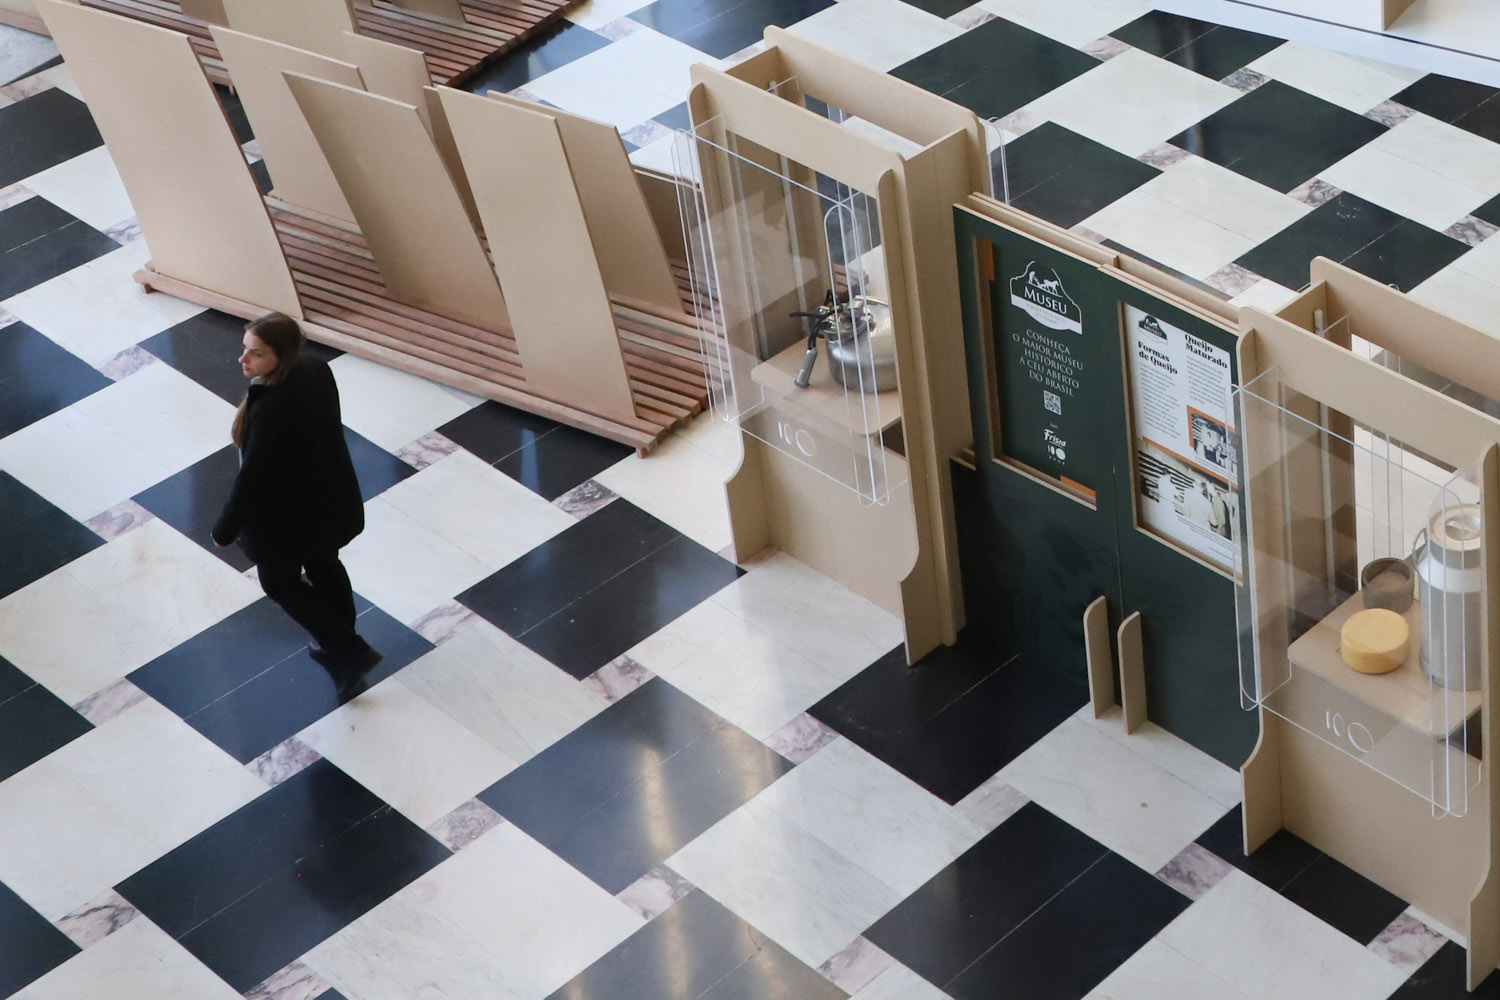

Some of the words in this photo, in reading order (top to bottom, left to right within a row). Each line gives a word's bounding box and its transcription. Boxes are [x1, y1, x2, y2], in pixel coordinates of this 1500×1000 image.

[1024, 286, 1067, 314] MUSEU
[1012, 333, 1020, 342] O
[1022, 337, 1051, 356] MAIOR
[1053, 352, 1083, 370] MUSEU
[1027, 329, 1070, 355] CONHEÇA
[1138, 341, 1170, 362] Formas
[1185, 334, 1213, 353] Queijo
[1138, 351, 1149, 360] de
[1150, 356, 1178, 375] Queijo
[1185, 343, 1227, 369] Maturado
[1029, 370, 1043, 382] DO
[1045, 377, 1073, 397] BRASIL
[1046, 369, 1079, 388] ABERTO
